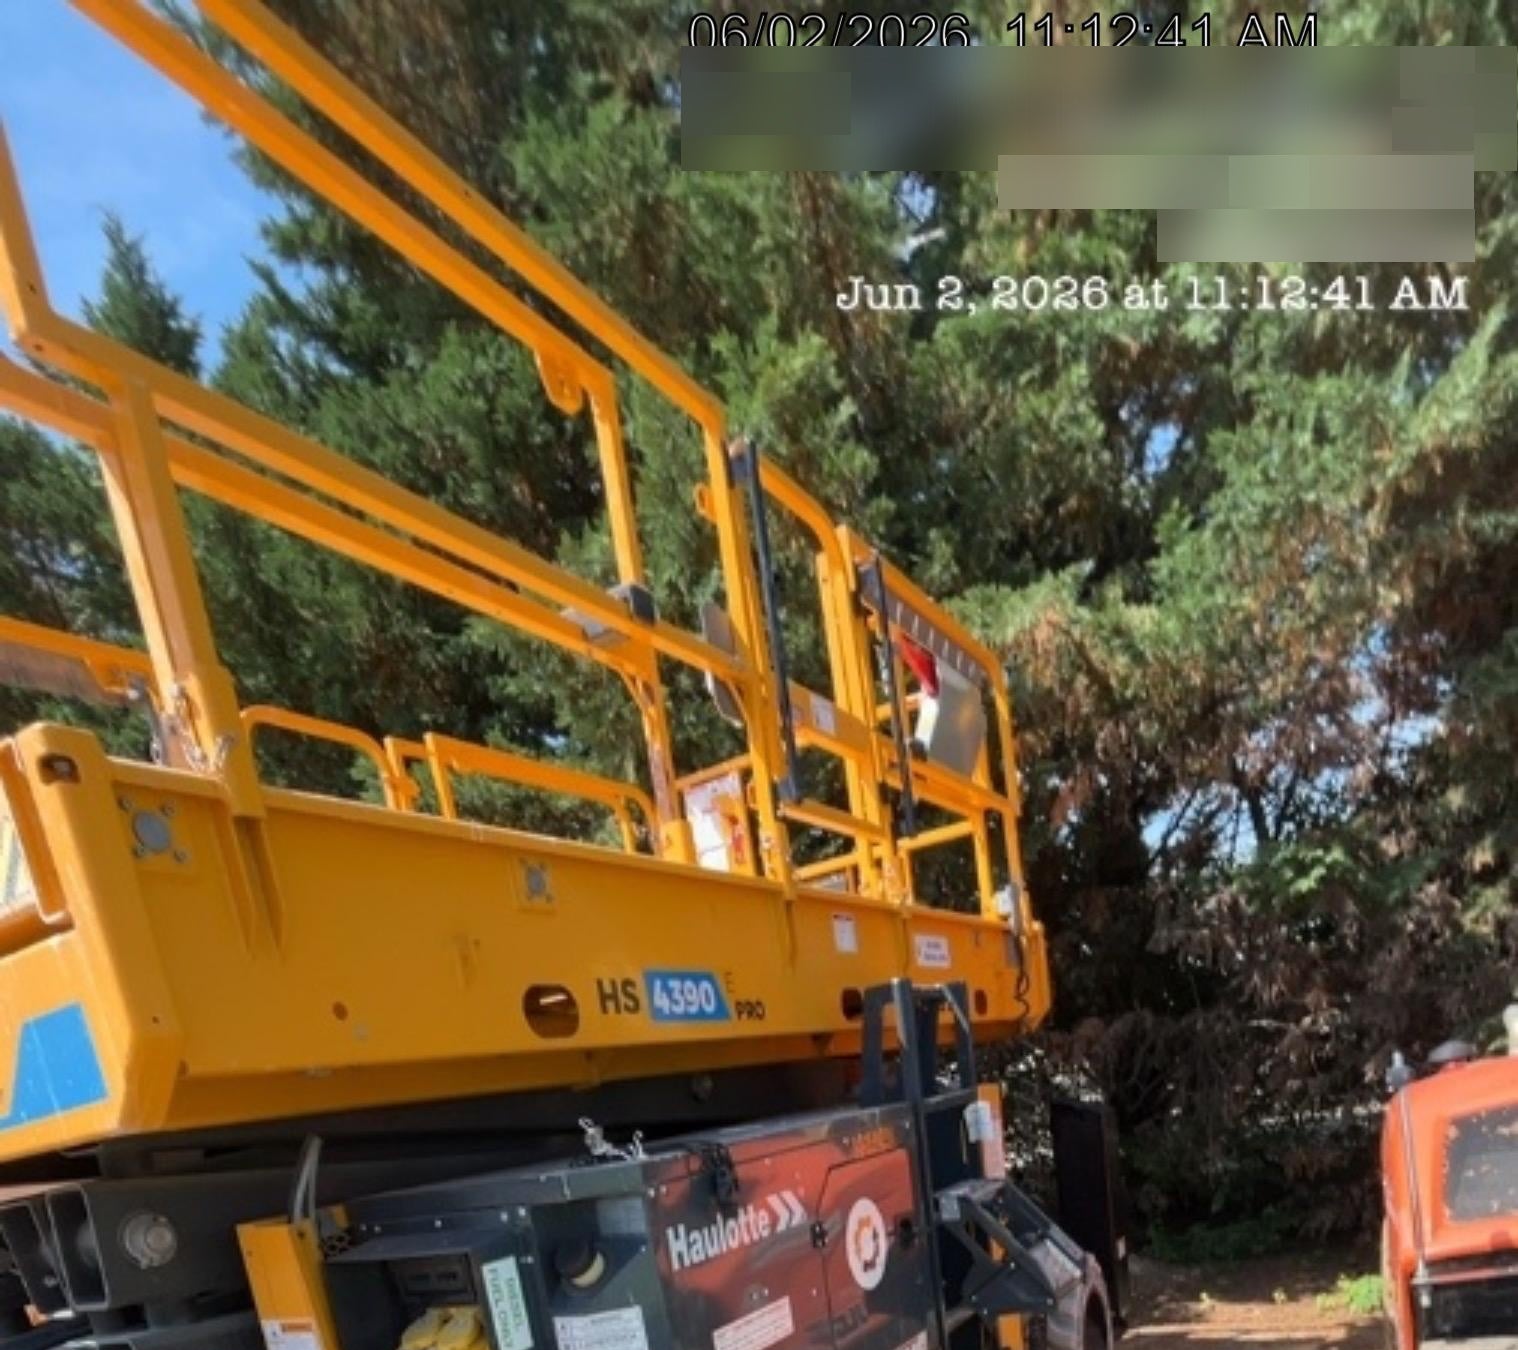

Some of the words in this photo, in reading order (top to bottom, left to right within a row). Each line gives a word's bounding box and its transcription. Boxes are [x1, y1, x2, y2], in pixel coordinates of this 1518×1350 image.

[596, 978, 640, 1015] HS
[653, 978, 715, 1015] 4390
[735, 1000, 765, 1020] PRO
[665, 1203, 771, 1272] Haulotte
[487, 1266, 505, 1308] FUEL
